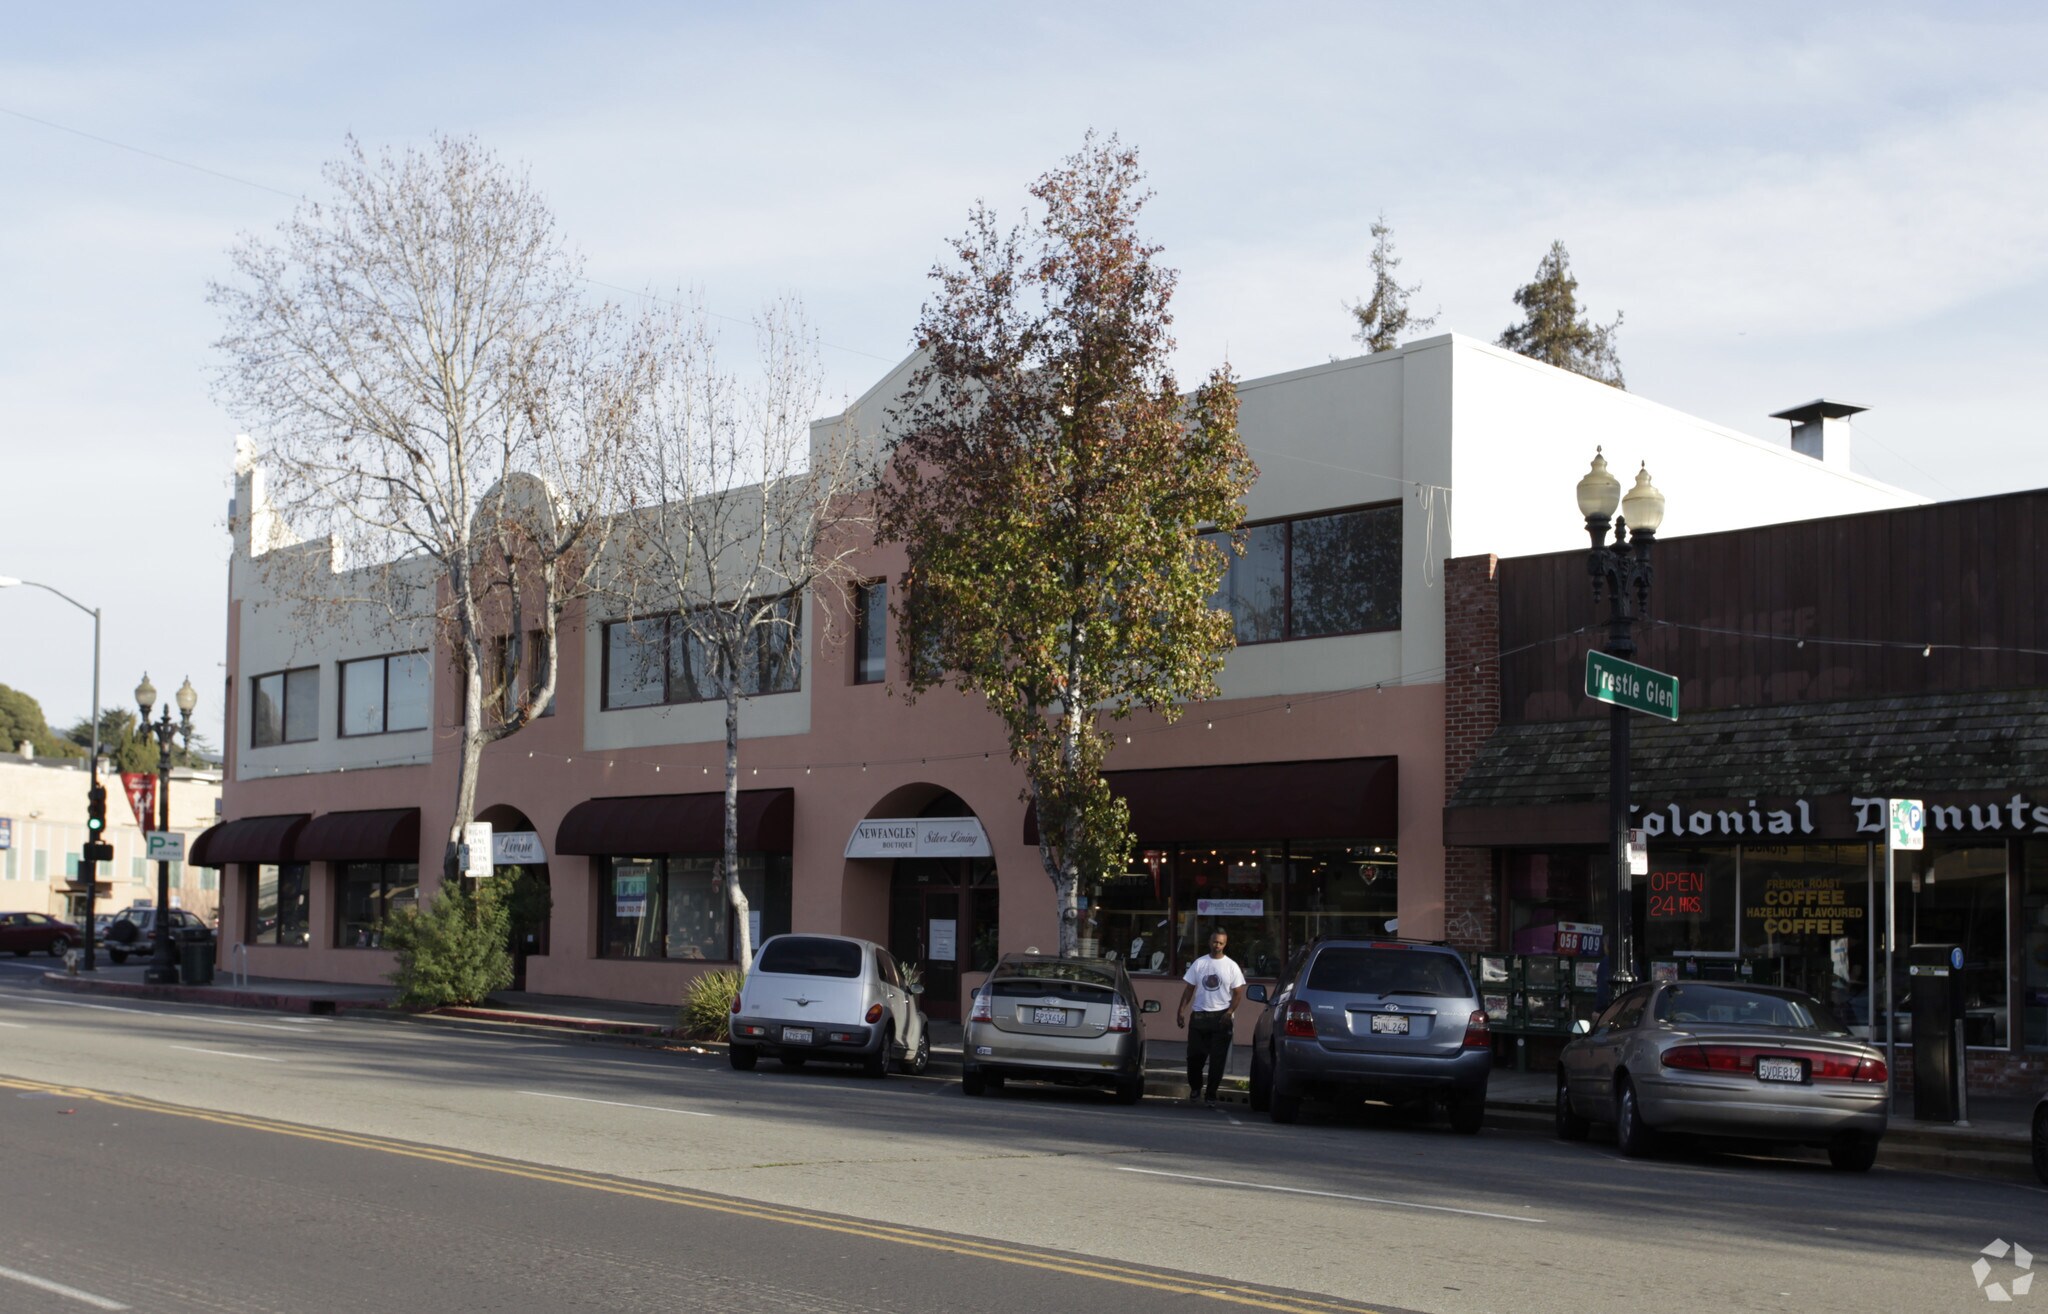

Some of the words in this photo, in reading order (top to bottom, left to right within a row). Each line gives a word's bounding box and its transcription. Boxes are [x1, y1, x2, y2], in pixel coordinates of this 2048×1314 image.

[1593, 663, 1640, 699] Trestle
[1646, 680, 1673, 708] Glen
[1850, 793, 2048, 834] Dnuts
[150, 836, 166, 855] P
[859, 827, 916, 839] NEWFANGLES
[924, 830, 948, 844] Silver
[949, 830, 978, 847] Lining
[882, 841, 913, 850] BOUTIQUE
[1650, 871, 1704, 893] OPEN
[1766, 879, 1805, 889] FRENCH
[1809, 878, 1840, 889] ROAST
[1650, 895, 1676, 917] 24
[1764, 889, 1845, 906] COFFEE
[1746, 907, 1798, 918] HAZELNUT
[1802, 907, 1864, 919] FLAVOURED
[1763, 918, 1845, 935] COFFEE
[1559, 932, 1578, 949] 056
[1582, 935, 1601, 952] 009
